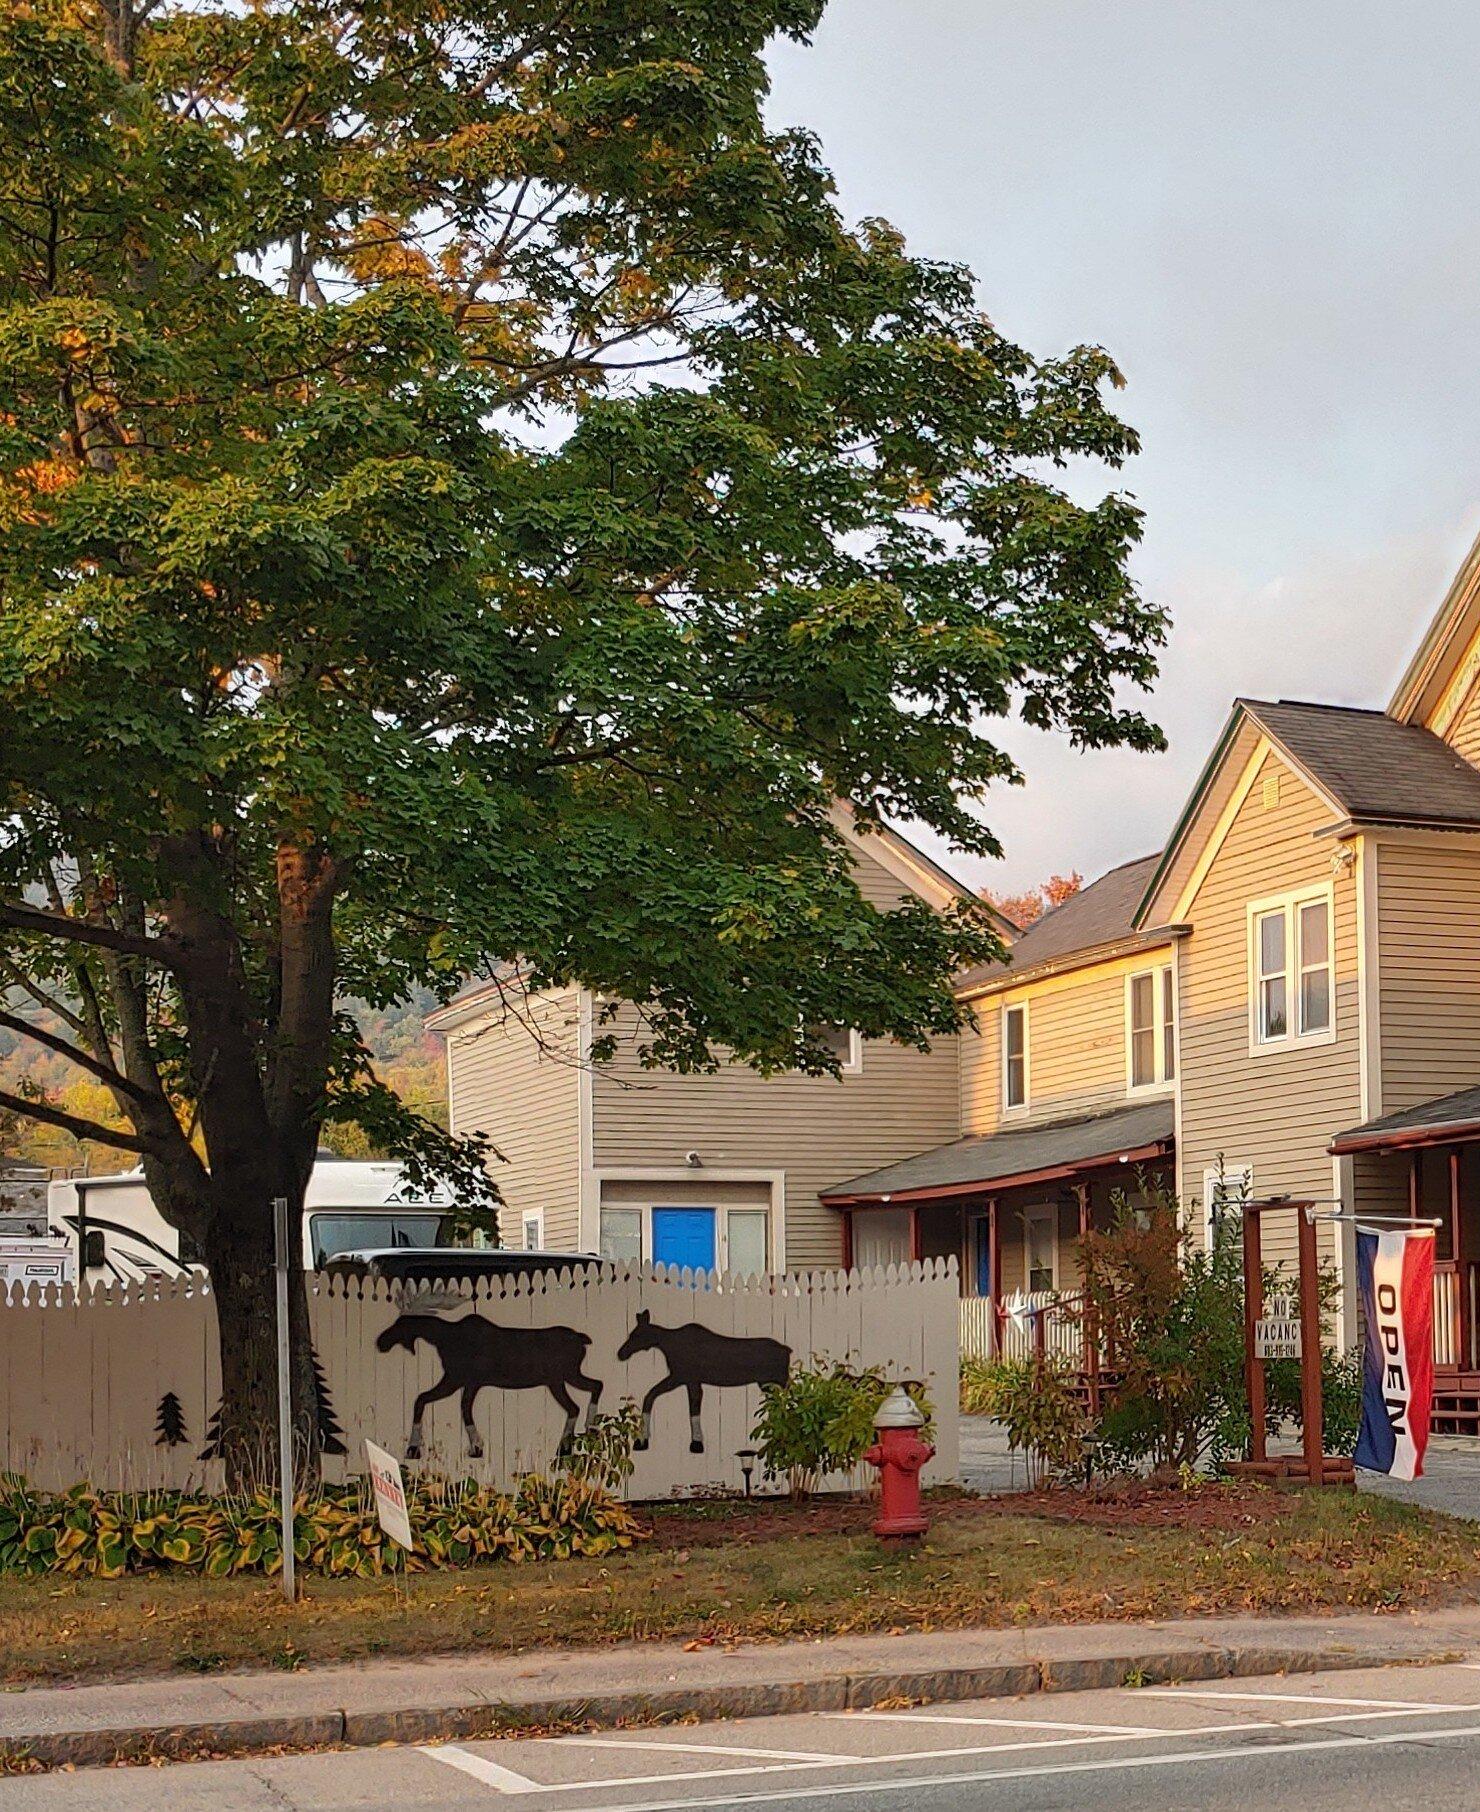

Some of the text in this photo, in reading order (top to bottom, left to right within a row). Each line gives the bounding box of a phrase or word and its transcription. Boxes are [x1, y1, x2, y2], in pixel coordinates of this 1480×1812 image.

[1273, 1300, 1286, 1316] NO
[1257, 1322, 1301, 1340] VACANC
[1378, 1284, 1407, 1435] OPEN
